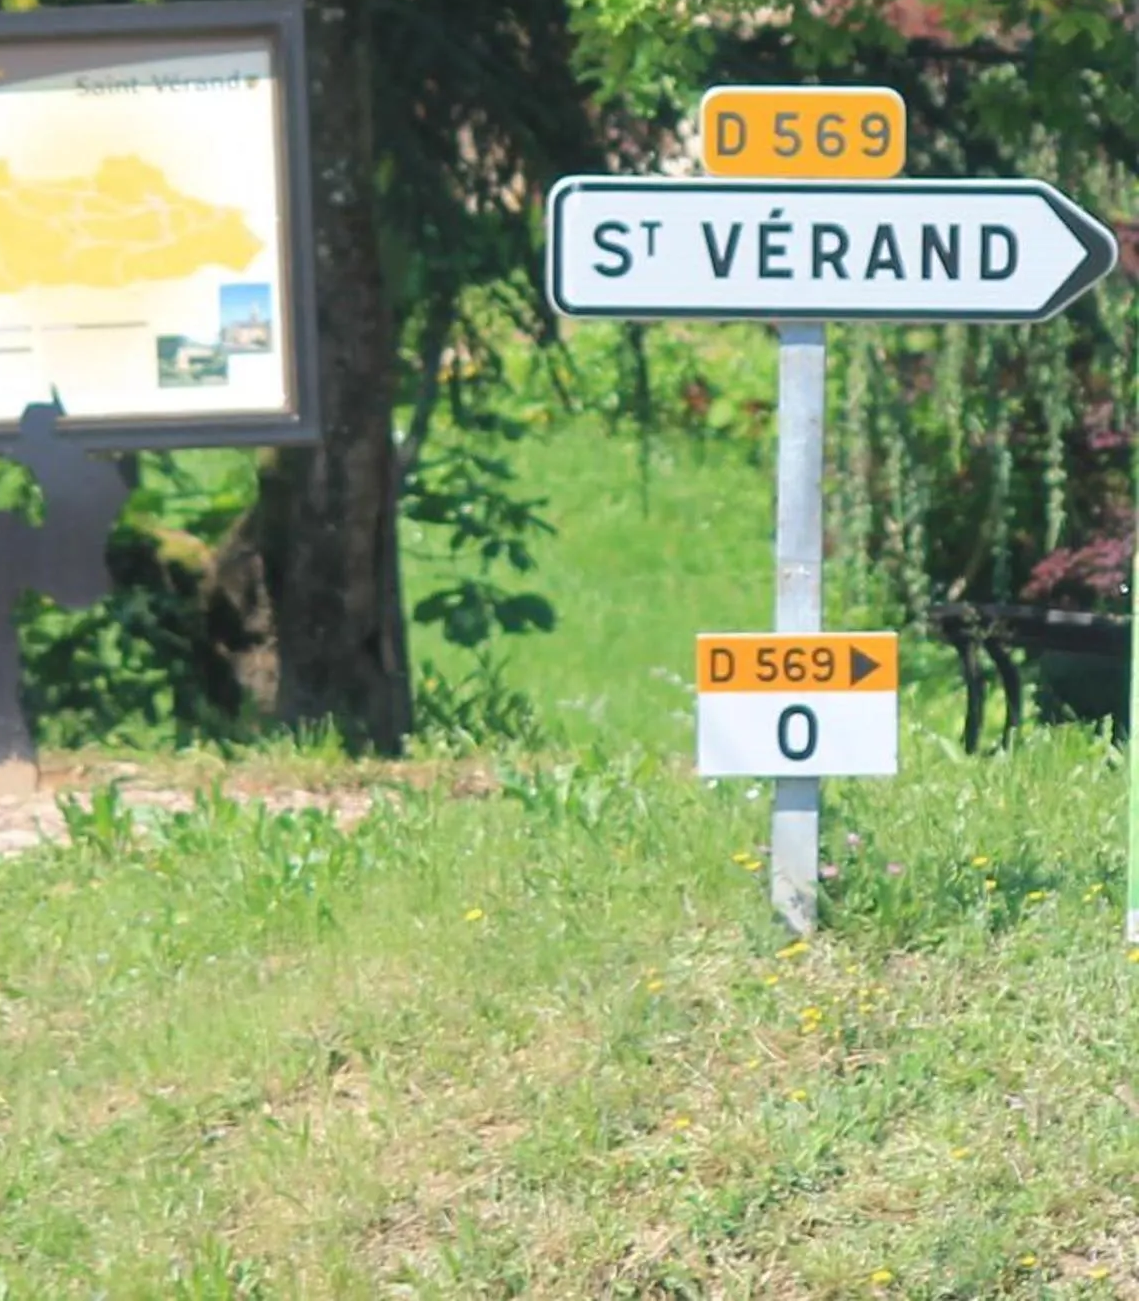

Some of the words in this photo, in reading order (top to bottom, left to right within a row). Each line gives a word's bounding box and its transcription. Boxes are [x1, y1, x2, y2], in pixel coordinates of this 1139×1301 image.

[715, 113, 747, 156] D
[773, 112, 892, 157] 569
[702, 209, 1019, 280] VÉRAND
[710, 648, 735, 682] D
[756, 647, 835, 683] 569
[777, 704, 818, 761] 0
